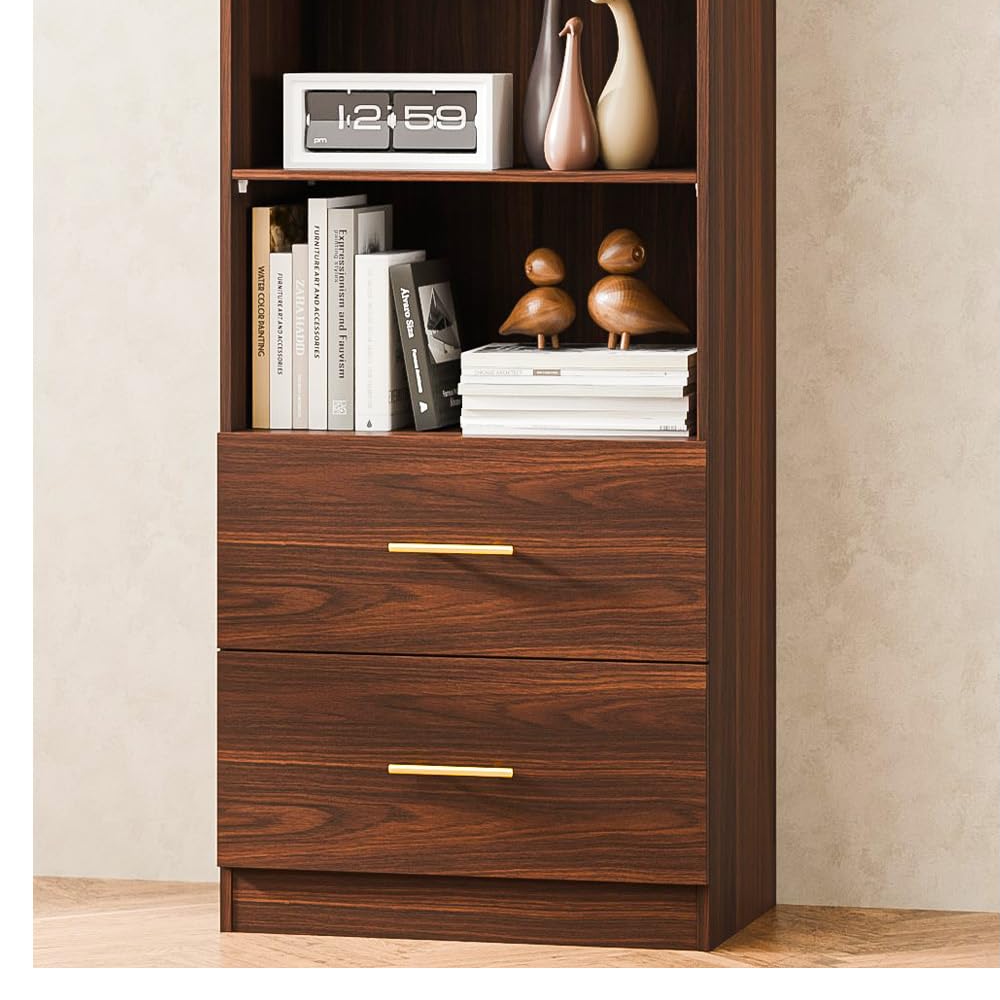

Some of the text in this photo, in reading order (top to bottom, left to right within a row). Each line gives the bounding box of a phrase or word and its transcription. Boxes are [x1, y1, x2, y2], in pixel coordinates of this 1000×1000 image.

[313, 136, 328, 144] pm
[257, 266, 265, 357] WATER COLOR PAINTING
[339, 229, 347, 379] Expressionism and Fauvism
